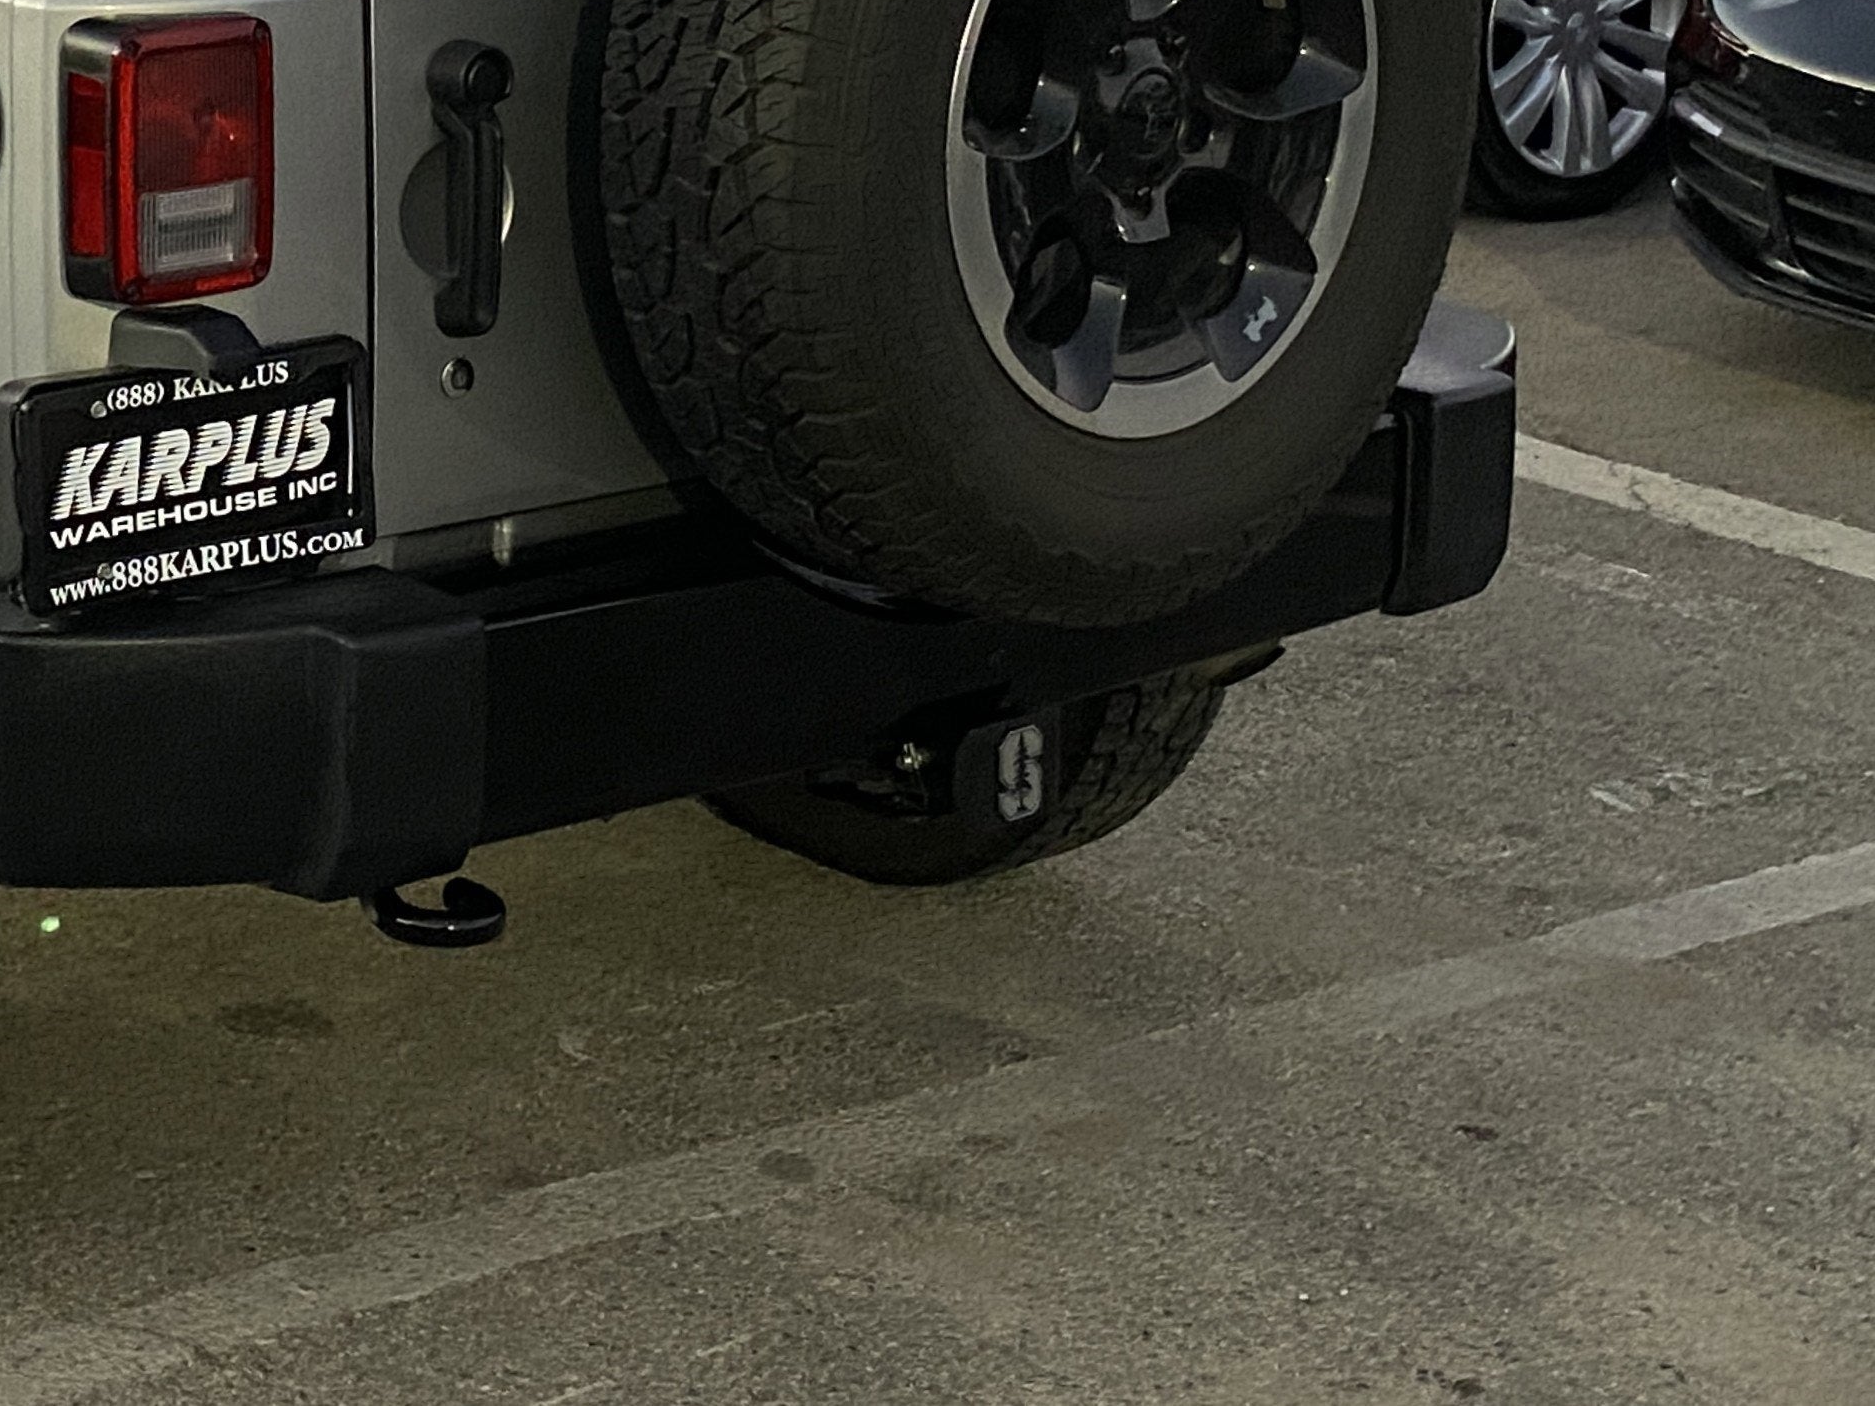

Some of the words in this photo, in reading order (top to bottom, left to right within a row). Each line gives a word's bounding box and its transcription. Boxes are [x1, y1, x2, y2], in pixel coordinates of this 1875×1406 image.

[106, 382, 165, 411] (888)
[172, 361, 289, 401] KARLUS
[50, 397, 336, 521] KARPLUS
[50, 487, 277, 550] WAREHOUSE
[288, 472, 337, 501] INC
